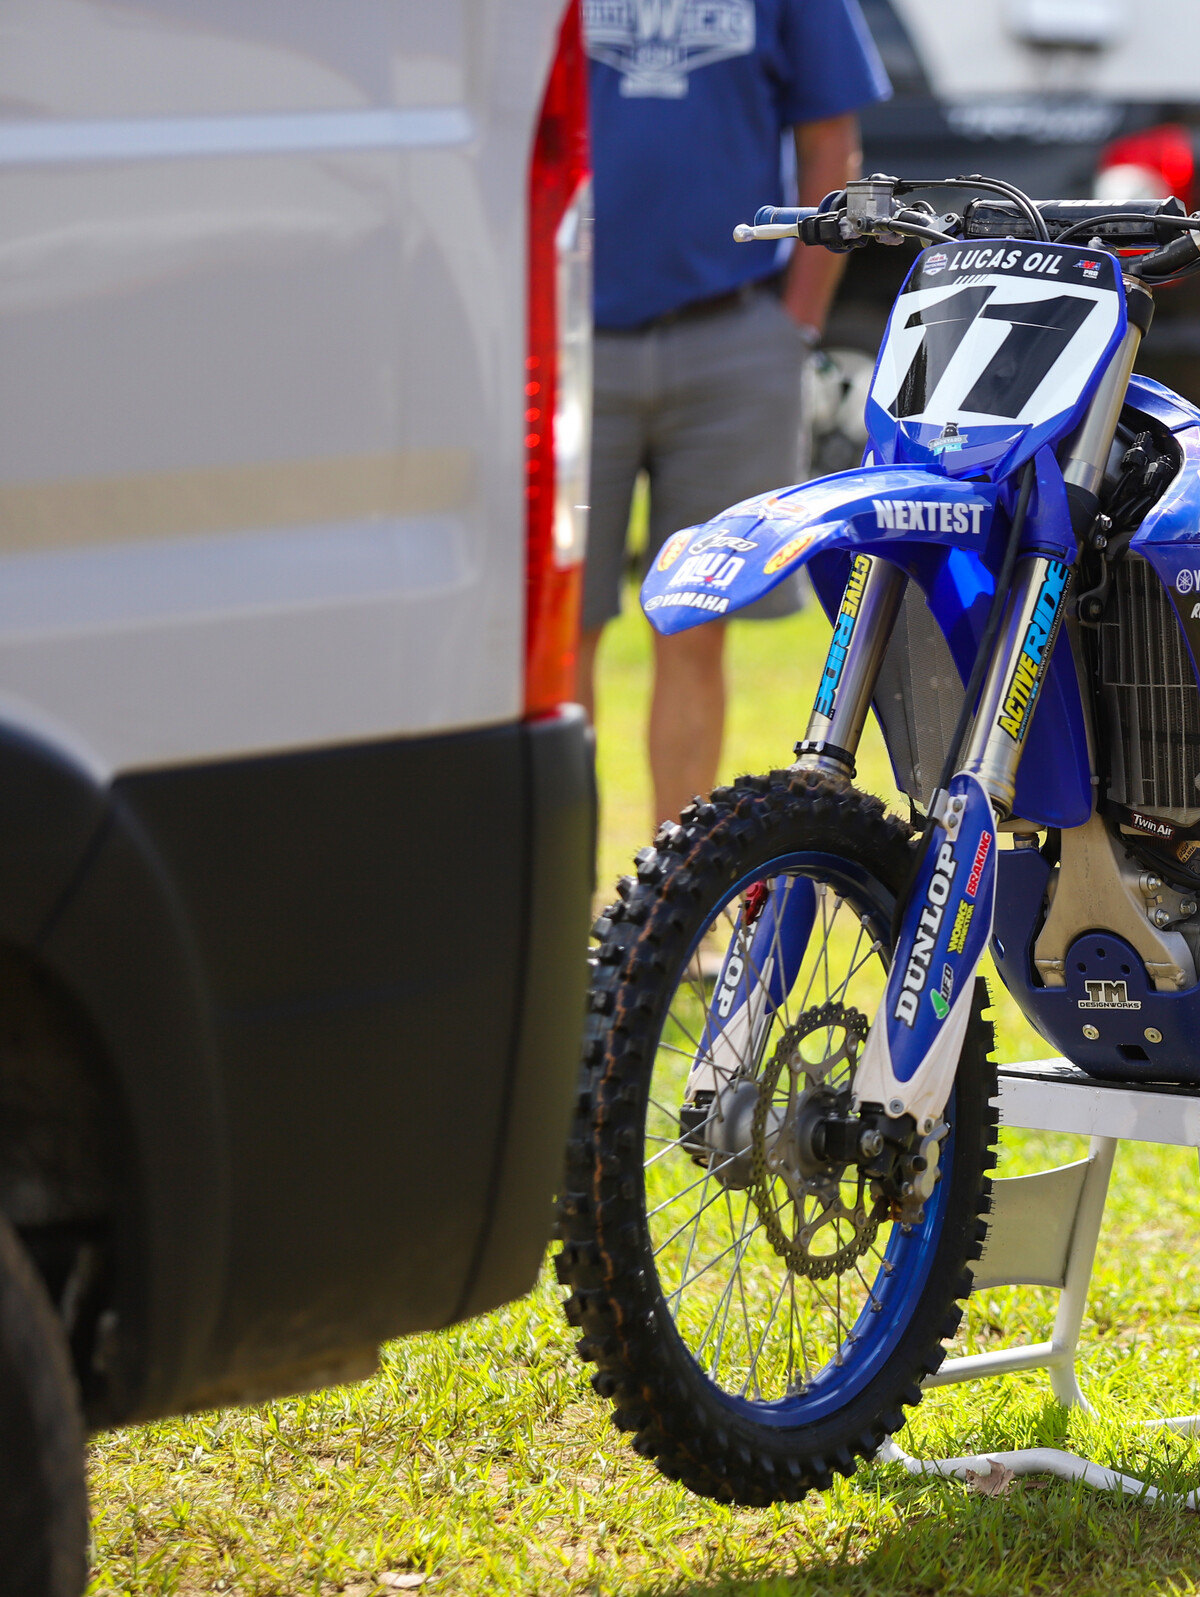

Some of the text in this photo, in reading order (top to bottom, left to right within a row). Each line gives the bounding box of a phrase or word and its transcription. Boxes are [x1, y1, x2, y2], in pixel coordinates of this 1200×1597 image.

[948, 249, 1022, 272] LUCAS
[1022, 252, 1063, 275] OIL
[887, 285, 1099, 419] 11
[872, 499, 985, 534] NEXTEST
[661, 592, 730, 613] YAMAHA
[1133, 814, 1156, 831] Twin
[1157, 825, 1173, 836] Air
[966, 831, 992, 897] BRAKING
[894, 842, 957, 1029] DUNLOP
[947, 899, 969, 953] WORKS
[957, 904, 975, 954] CONNECTION
[941, 963, 954, 1003] UFO
[1086, 982, 1127, 1002] TM
[1079, 1001, 1140, 1009] DESIGNWORKS
